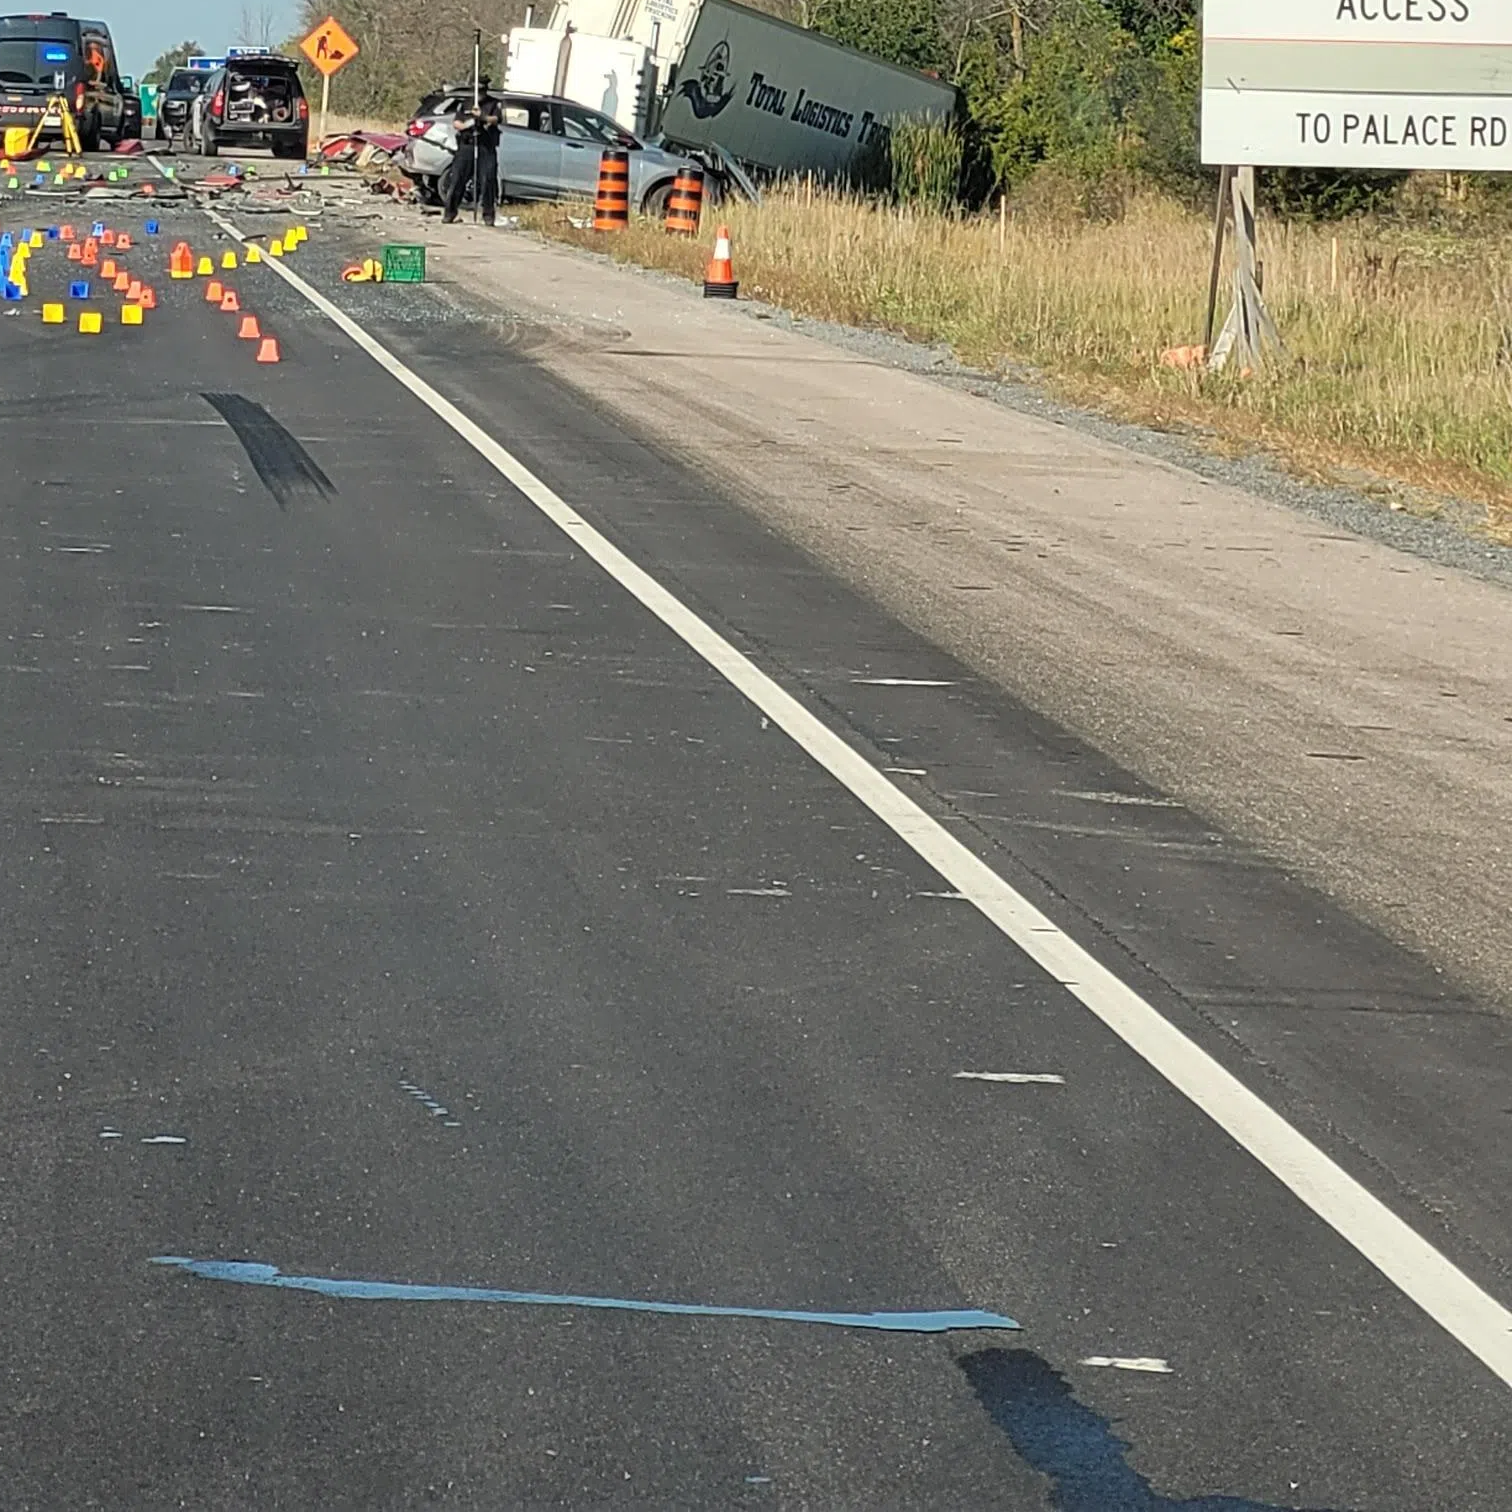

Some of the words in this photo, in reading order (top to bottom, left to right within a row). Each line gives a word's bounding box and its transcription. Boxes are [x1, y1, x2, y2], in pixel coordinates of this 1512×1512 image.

[1296, 113, 1331, 144] TO
[1343, 114, 1457, 146] PALACE
[1470, 116, 1507, 147] RD
